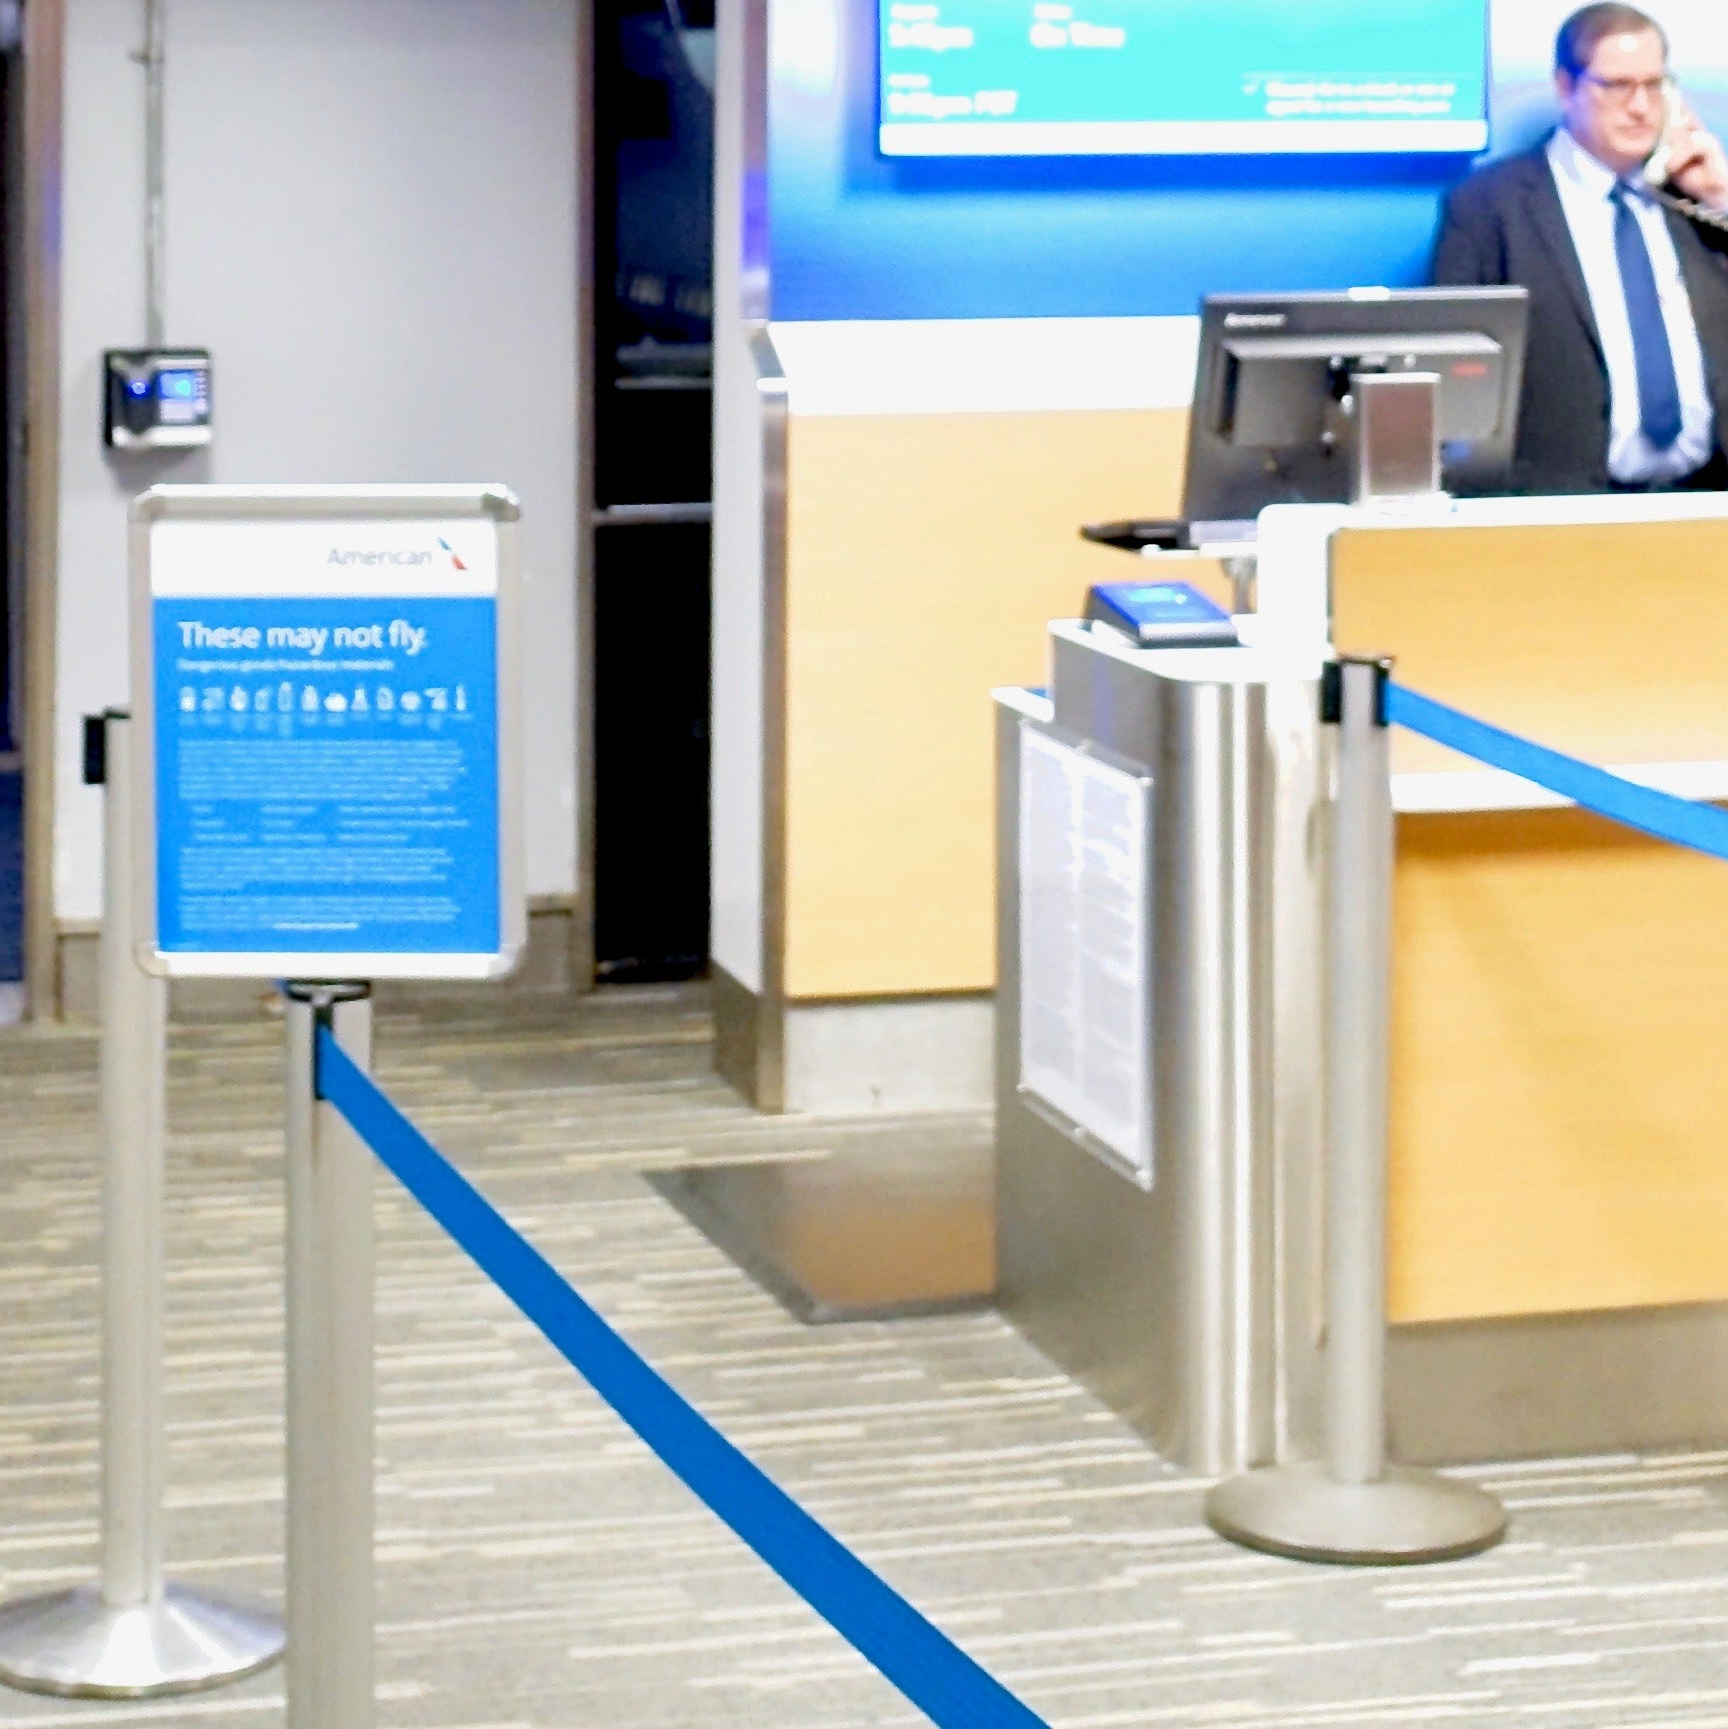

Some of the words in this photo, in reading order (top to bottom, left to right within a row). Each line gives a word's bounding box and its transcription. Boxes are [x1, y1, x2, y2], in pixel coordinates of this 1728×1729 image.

[327, 547, 434, 566] American
[177, 621, 262, 650] These
[267, 626, 330, 657] may
[333, 624, 384, 650] not
